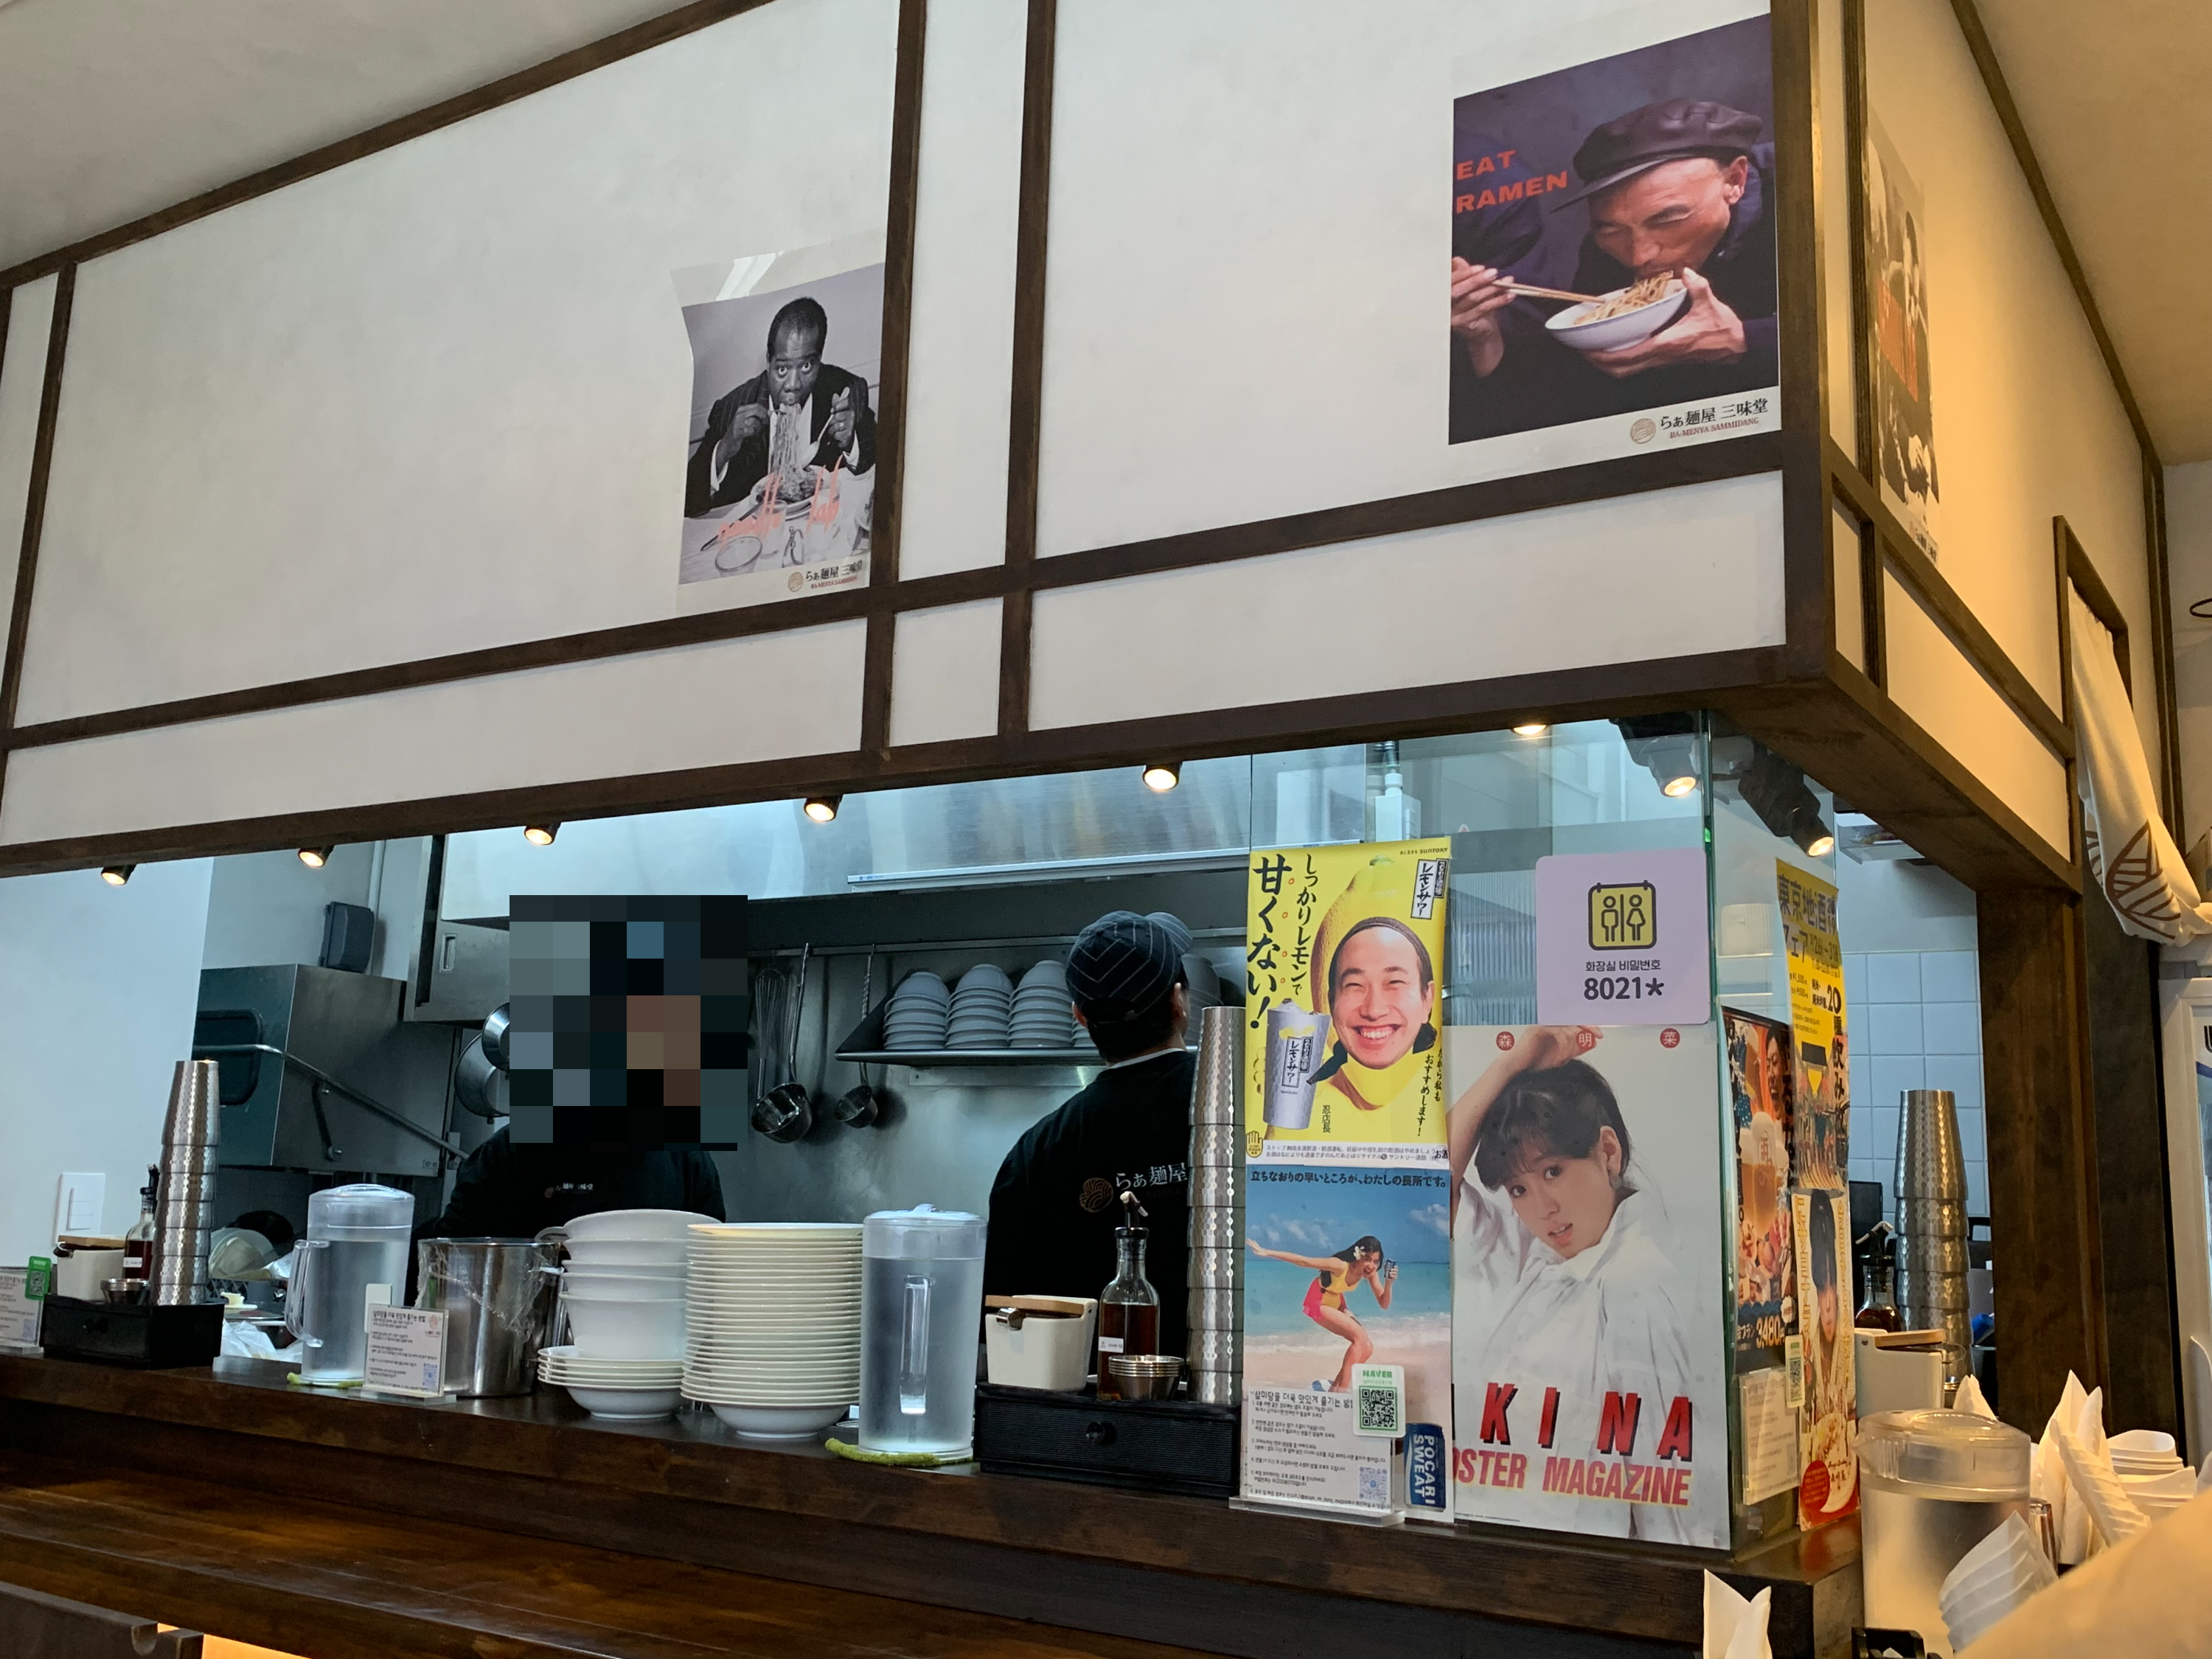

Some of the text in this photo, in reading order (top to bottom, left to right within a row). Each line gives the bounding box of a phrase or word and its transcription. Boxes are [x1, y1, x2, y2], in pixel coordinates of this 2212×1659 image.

[1456, 150, 1517, 181] EAT
[1456, 170, 1568, 215] RAMEN
[1711, 417, 1759, 432] SAMMIDANG
[1720, 398, 1768, 420] 三味堂
[1416, 863, 1433, 916] レモンサワー
[1290, 853, 1318, 995] しっかりレモンで
[1585, 959, 1661, 972] 화장실 비밀번호
[1578, 1033, 1592, 1048] 明
[1663, 1031, 1677, 1046] 菜
[1251, 1171, 1446, 1189] 立ちなおりの早いところが、わたしの長所です。
[1363, 1370, 1393, 1379] NAVER
[1283, 1393, 1295, 1403] 더욱
[1298, 1394, 1318, 1405] 맛있게
[1321, 1396, 1340, 1408] 즐기는
[1453, 1382, 1692, 1462] KINA
[1413, 1434, 1425, 1496] SWEAT
[1424, 1435, 1436, 1506] POCARI
[1542, 1456, 1692, 1506] MAGAZINE
